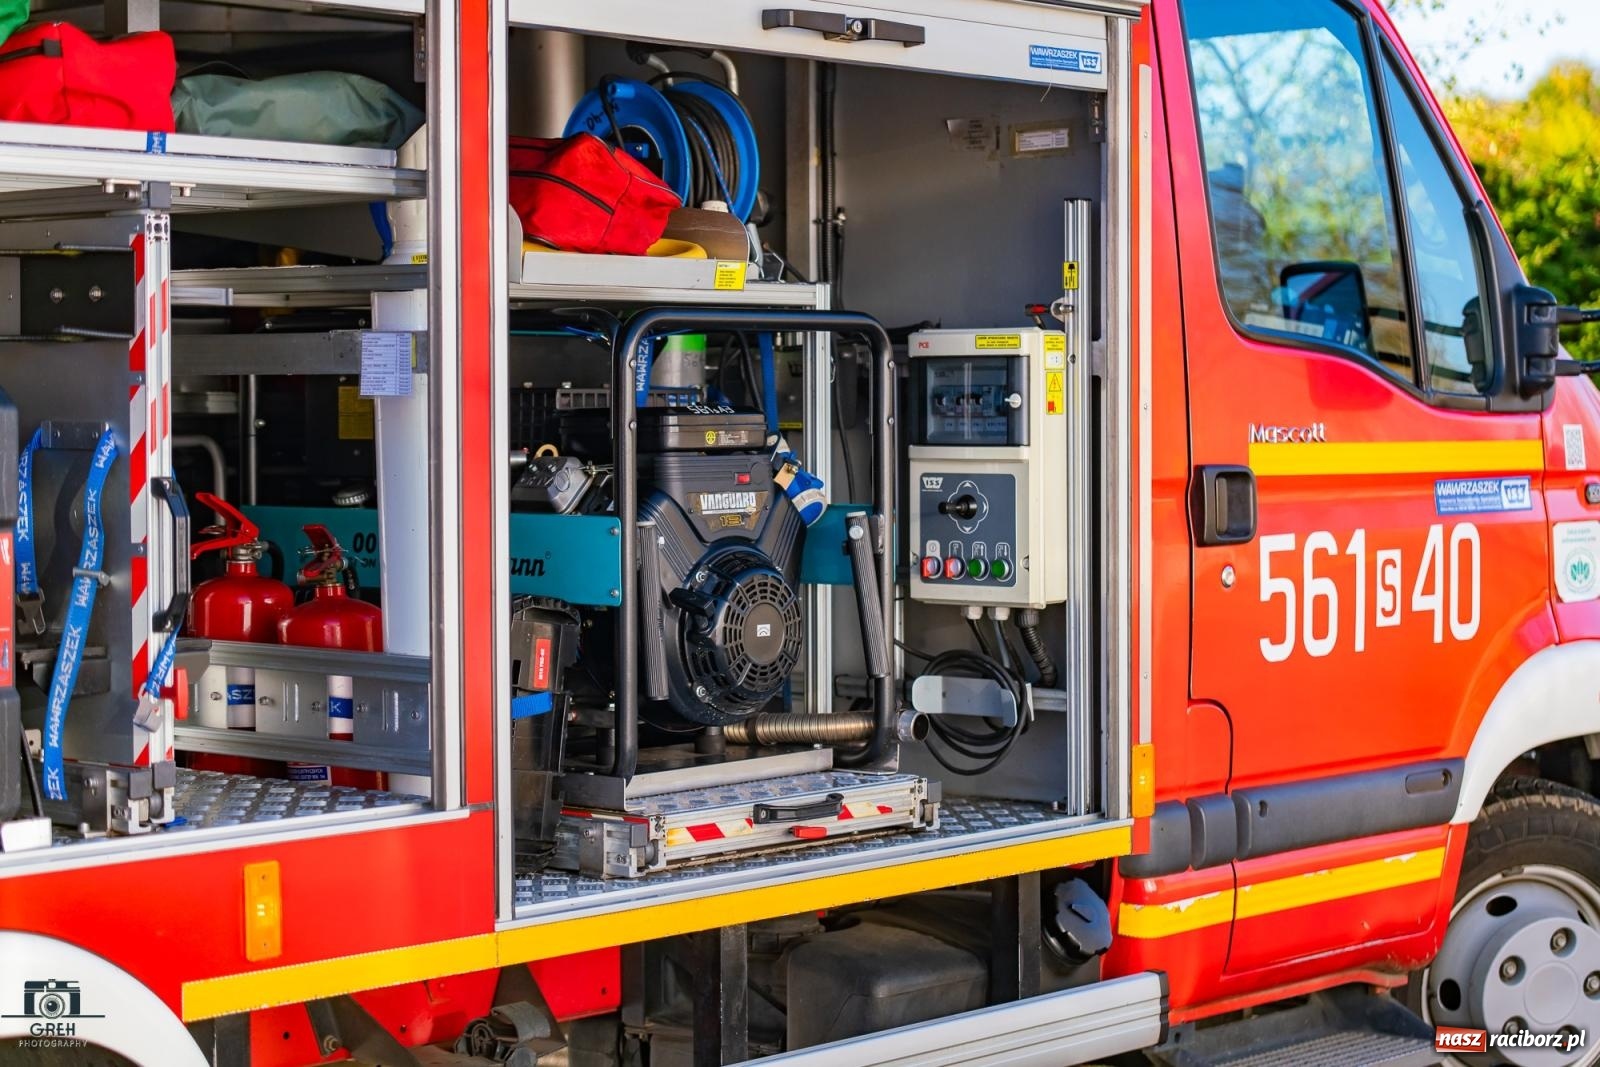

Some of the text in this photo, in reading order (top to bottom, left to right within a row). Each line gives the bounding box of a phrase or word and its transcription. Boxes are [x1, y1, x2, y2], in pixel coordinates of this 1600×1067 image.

[1030, 47, 1077, 59] WAWRZASZEK
[1249, 423, 1326, 443] Mascott
[1436, 481, 1499, 496] WAWRZASZEK
[700, 492, 757, 510] VANGUARD
[48, 624, 82, 748] WAWRZASZEK
